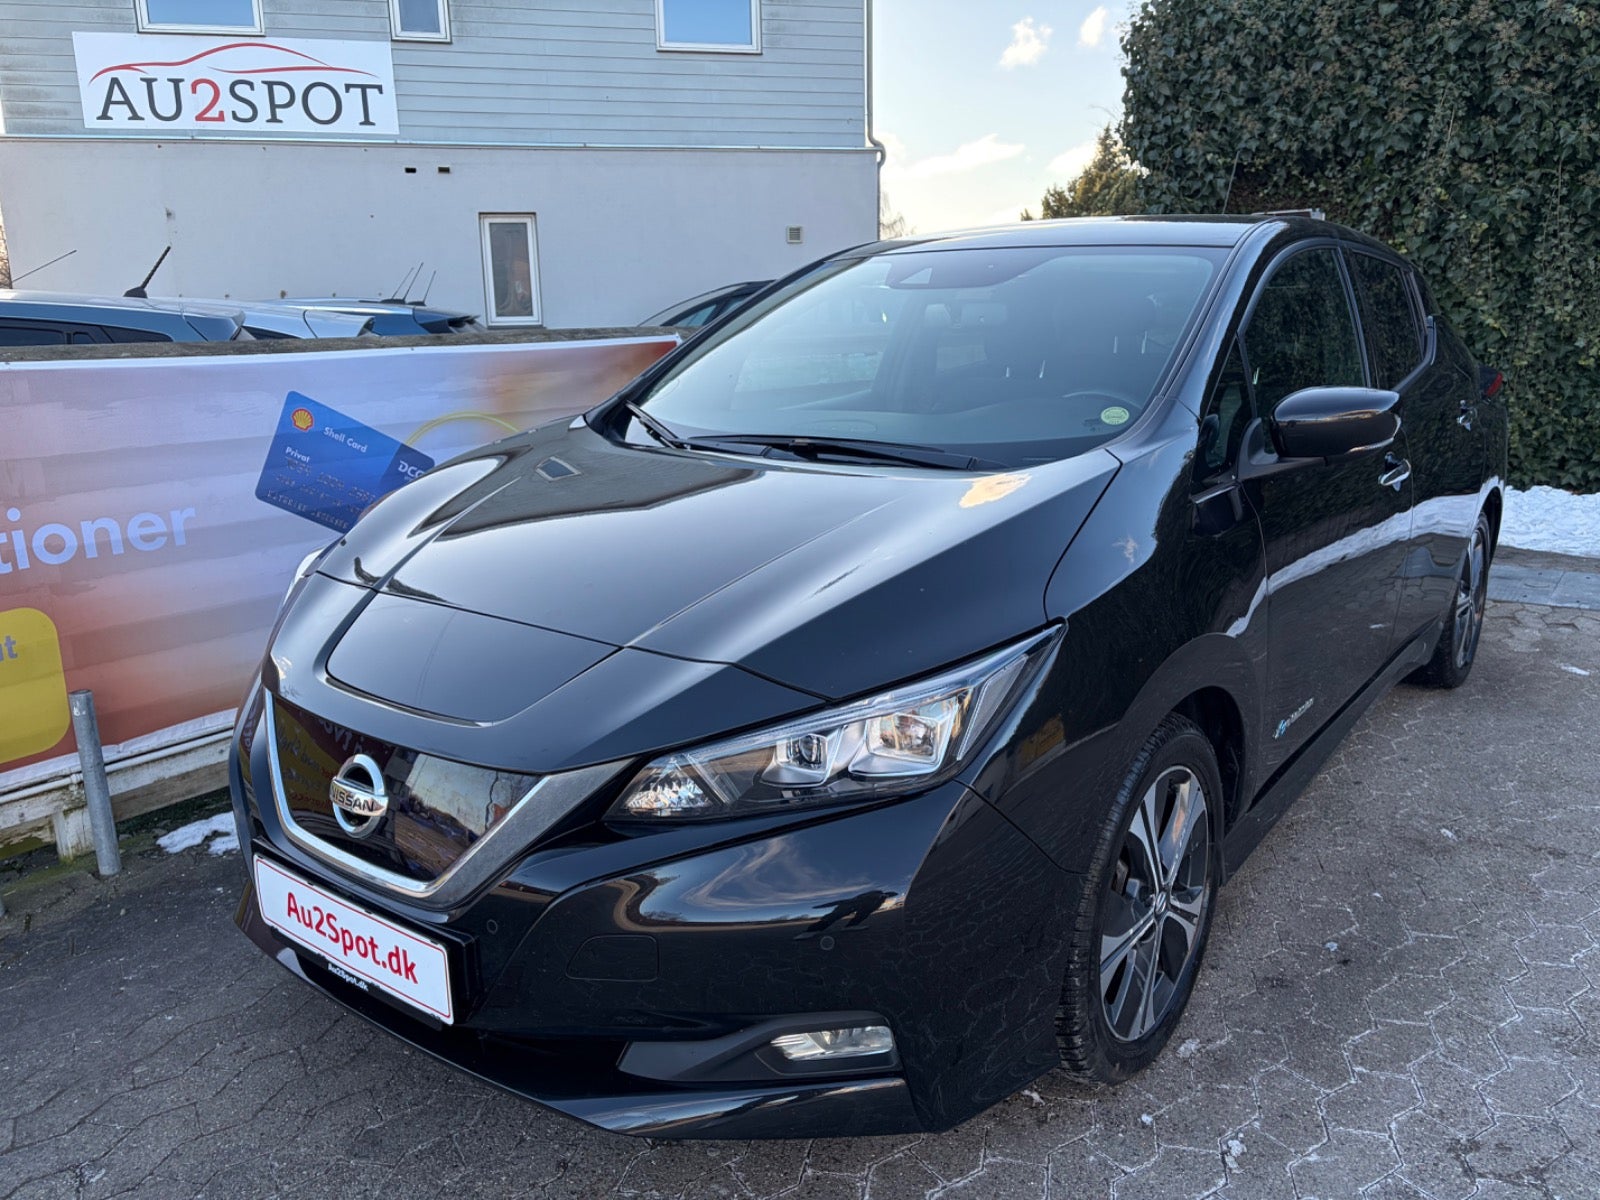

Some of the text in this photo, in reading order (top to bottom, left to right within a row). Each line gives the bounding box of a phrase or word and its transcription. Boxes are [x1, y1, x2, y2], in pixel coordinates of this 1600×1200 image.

[96, 76, 384, 127] AU2SPOT
[323, 426, 368, 453] Shell Card
[285, 446, 311, 463] Privat
[332, 787, 375, 813] NISSAN
[287, 891, 419, 985] Au2Spot.dk
